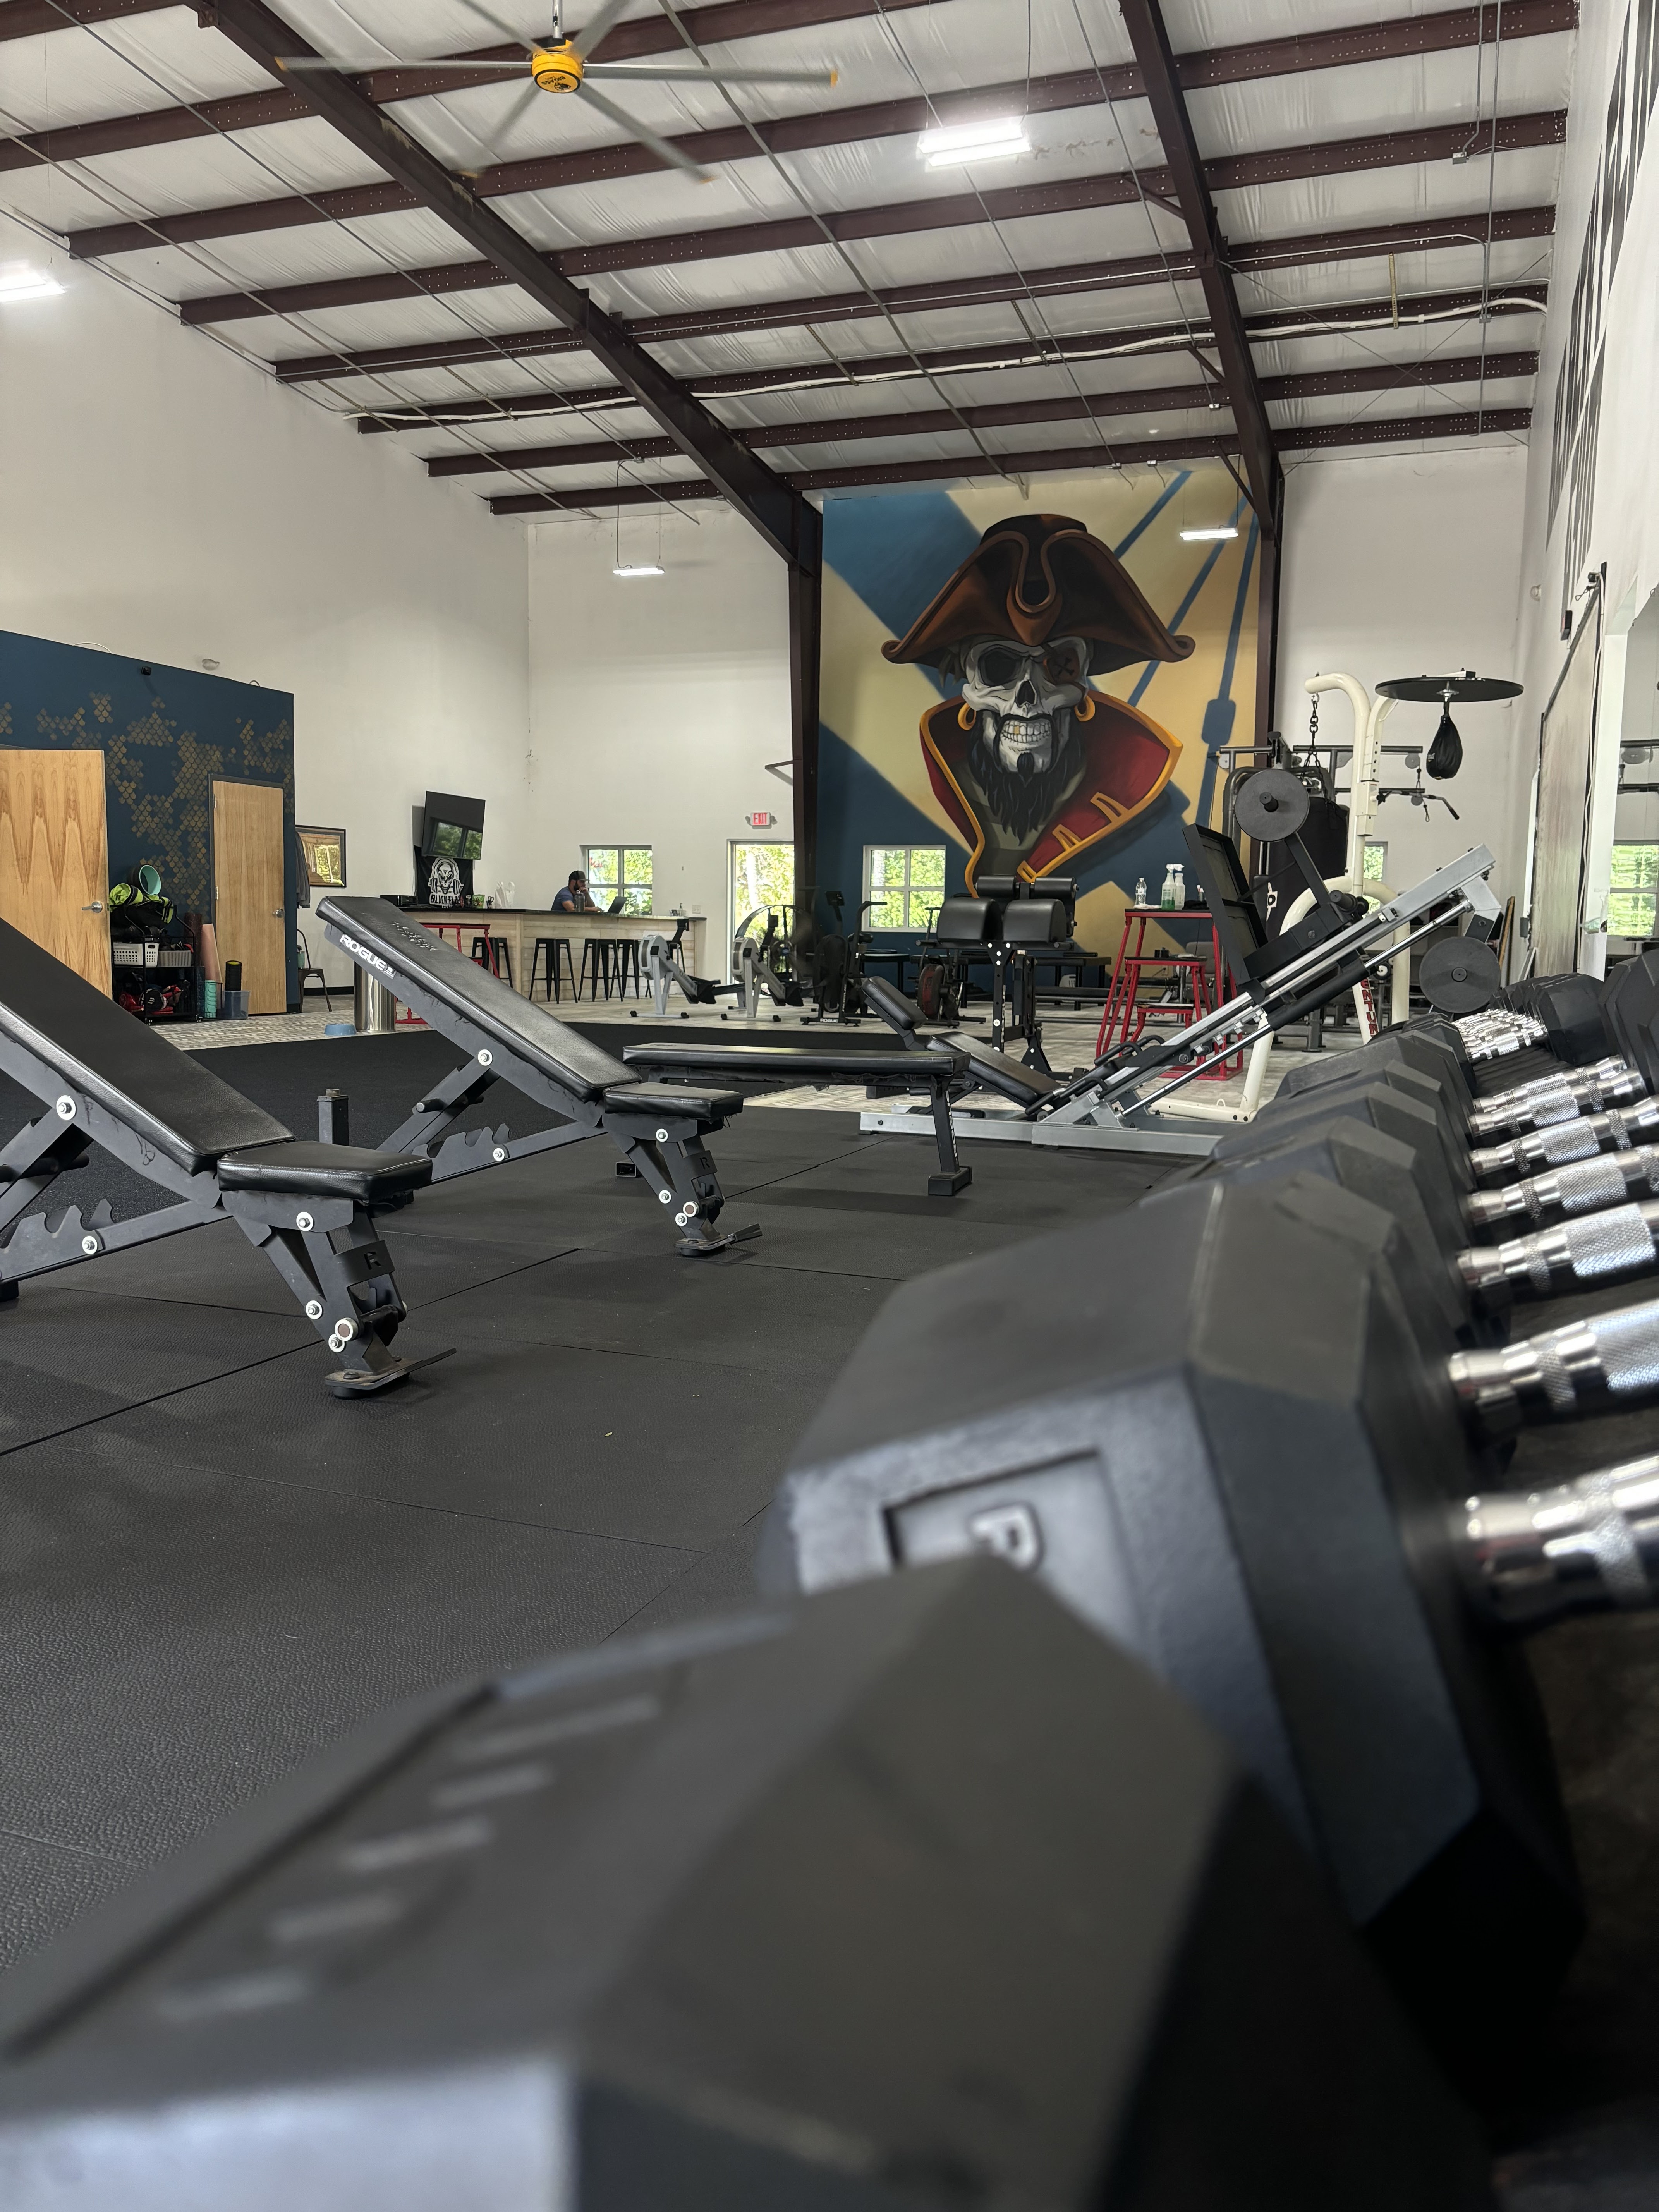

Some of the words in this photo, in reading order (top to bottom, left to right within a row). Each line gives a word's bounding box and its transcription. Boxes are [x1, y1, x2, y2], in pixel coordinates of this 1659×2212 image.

[1546, 146, 1602, 551] BLACK
[1594, 0, 1659, 359] FLA
[753, 813, 767, 824] EXIT
[430, 894, 448, 905] BLACK
[340, 934, 387, 971] ROGUE
[699, 1157, 710, 1169] R
[364, 1251, 381, 1270] R
